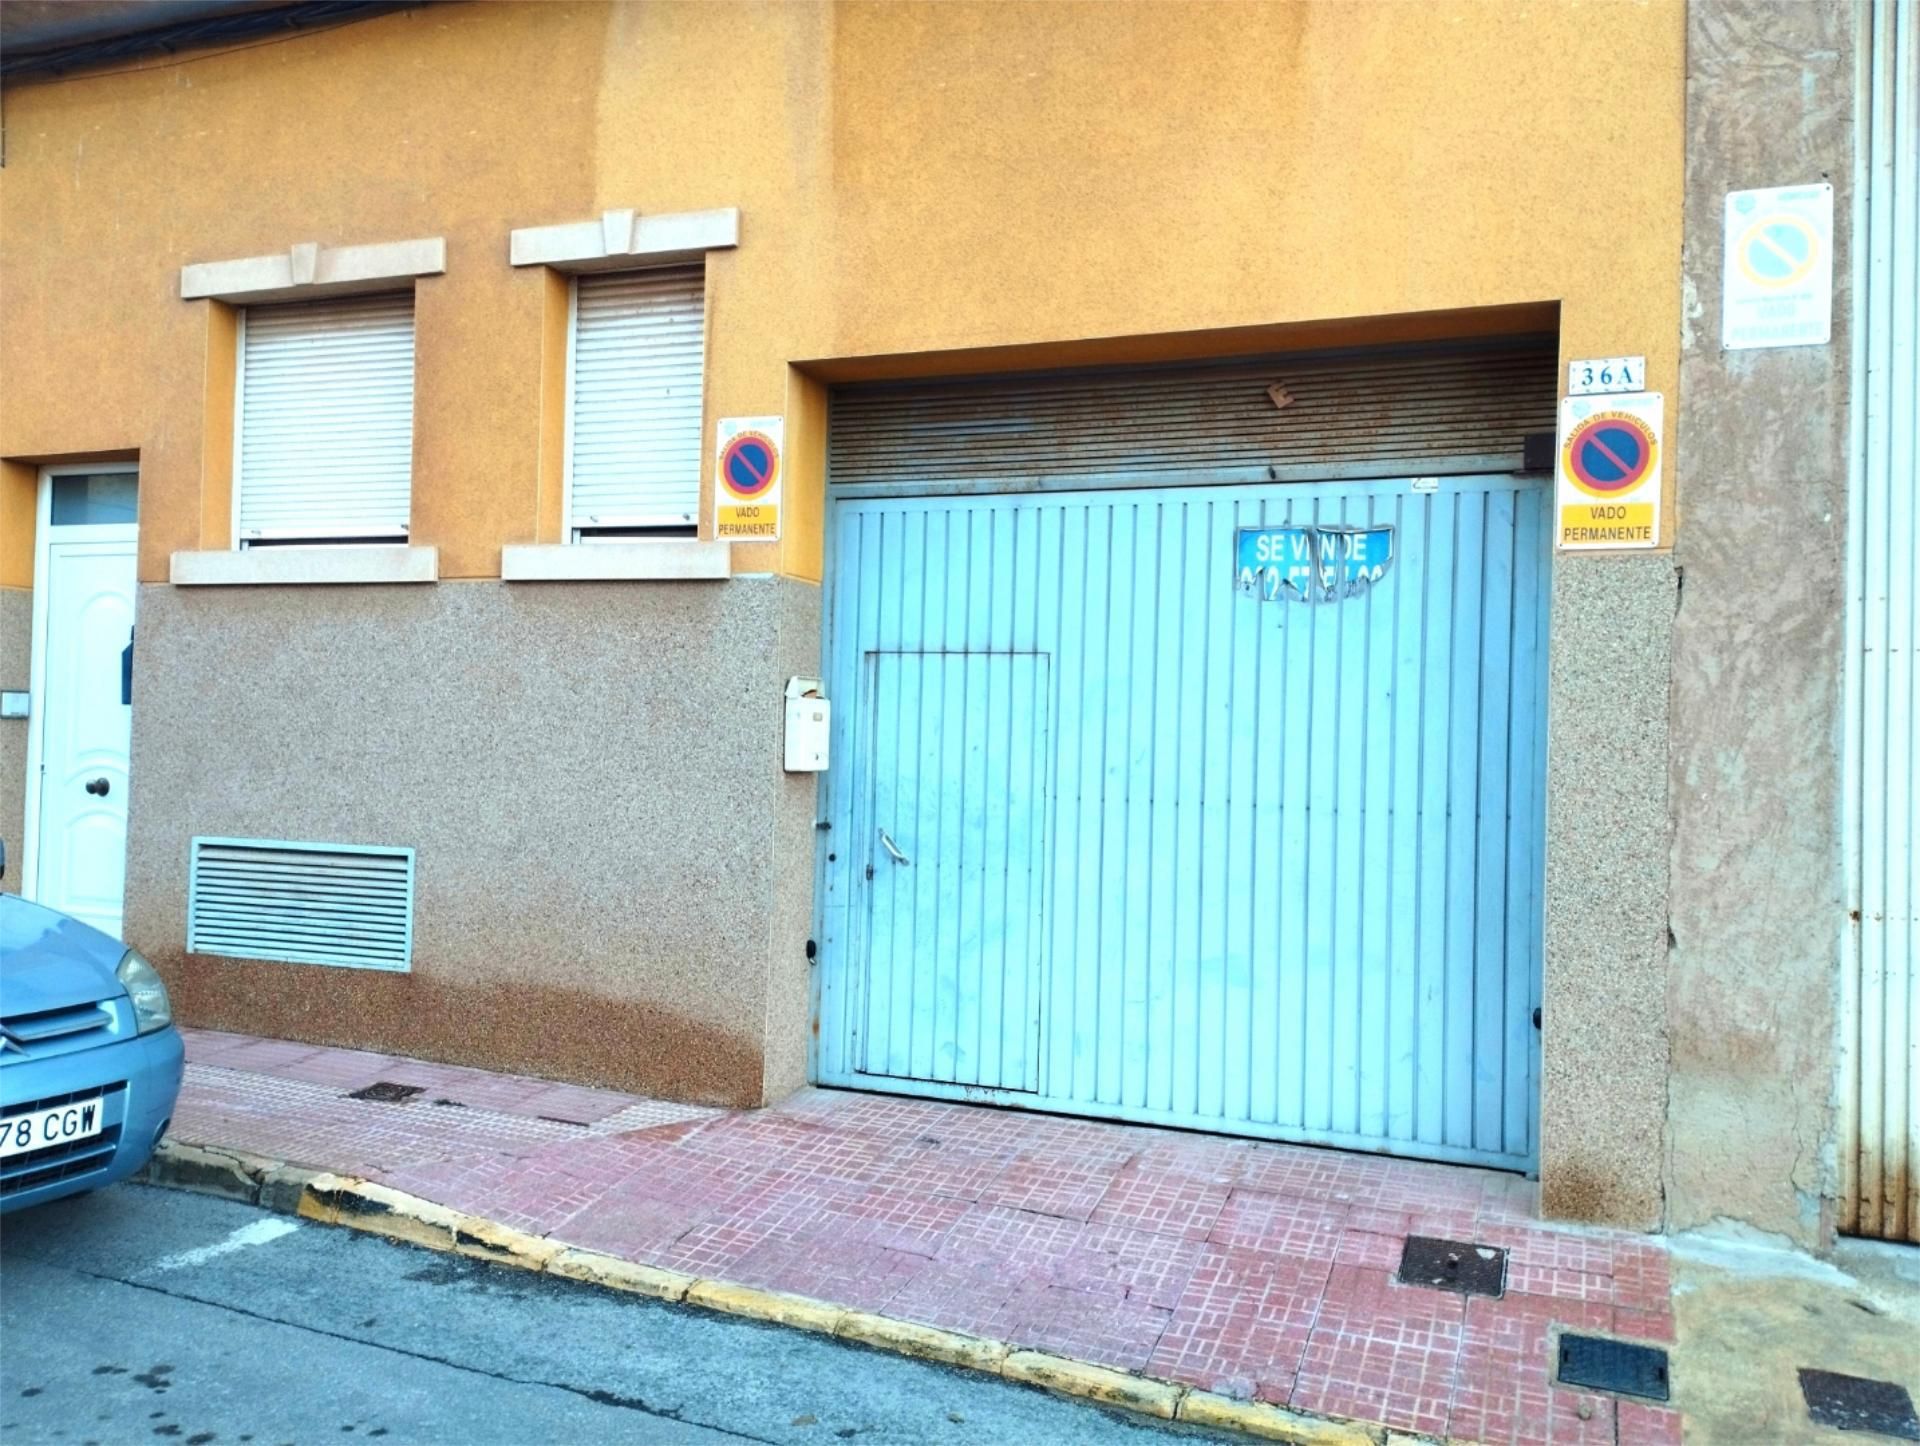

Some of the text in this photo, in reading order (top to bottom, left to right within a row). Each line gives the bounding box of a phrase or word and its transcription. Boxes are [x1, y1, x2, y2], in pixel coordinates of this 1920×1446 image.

[1581, 365, 1633, 386] 36A
[1563, 419, 1590, 449] SALIDA
[1593, 411, 1606, 421] DE
[736, 506, 760, 518] VADO
[1590, 506, 1626, 519] VADO
[718, 522, 776, 535] PERMANENTE
[1563, 526, 1652, 541] PERMANENTE
[1256, 533, 1367, 561] SE VNDE
[0, 1104, 95, 1147] 78 CGW
